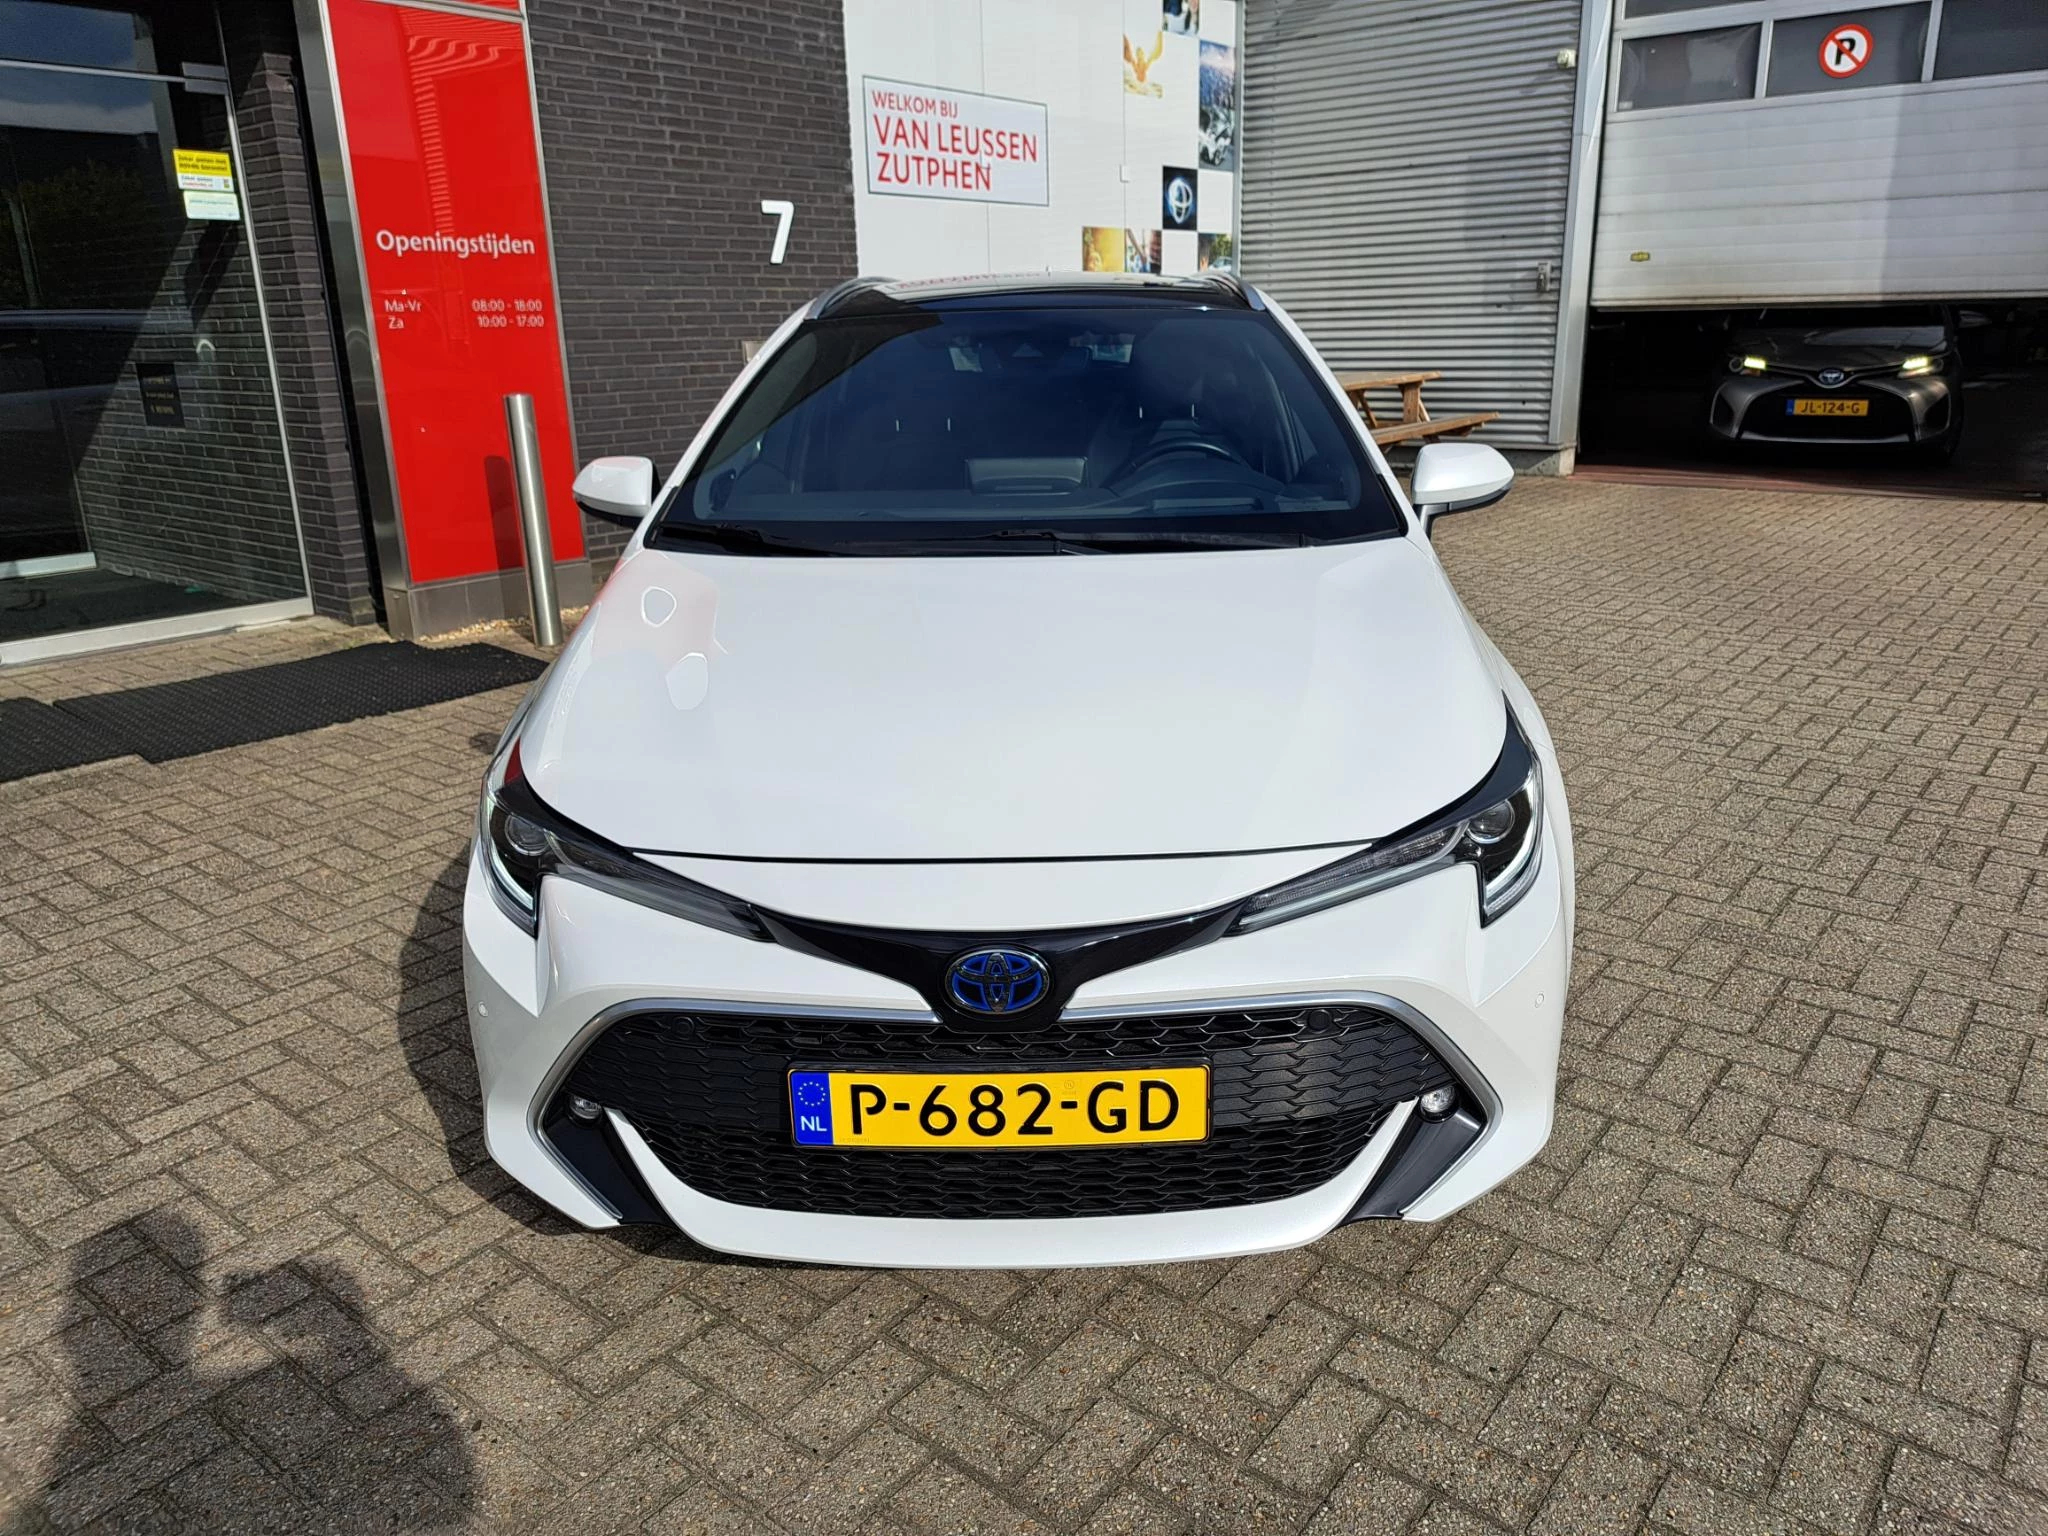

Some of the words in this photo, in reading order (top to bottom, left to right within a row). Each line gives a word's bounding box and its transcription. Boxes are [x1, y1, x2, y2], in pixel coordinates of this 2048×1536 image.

[1835, 37, 1856, 65] P
[872, 91, 936, 115] WELKOM
[940, 101, 958, 118] BIJ
[873, 114, 929, 151] VAN
[937, 122, 1037, 162] LEUSSEN
[876, 152, 991, 191] ZUTPHEN
[376, 229, 535, 258] Openingstijden
[761, 200, 794, 263] 7
[472, 299, 505, 312] 08:00
[514, 299, 543, 312] 18:00
[388, 316, 405, 329] Za
[477, 315, 507, 328] 10:00
[516, 315, 544, 328] 17:00
[1801, 402, 1860, 414] JL-124-G
[849, 1080, 1180, 1136] P-682-GD
[801, 1115, 827, 1132] NL
